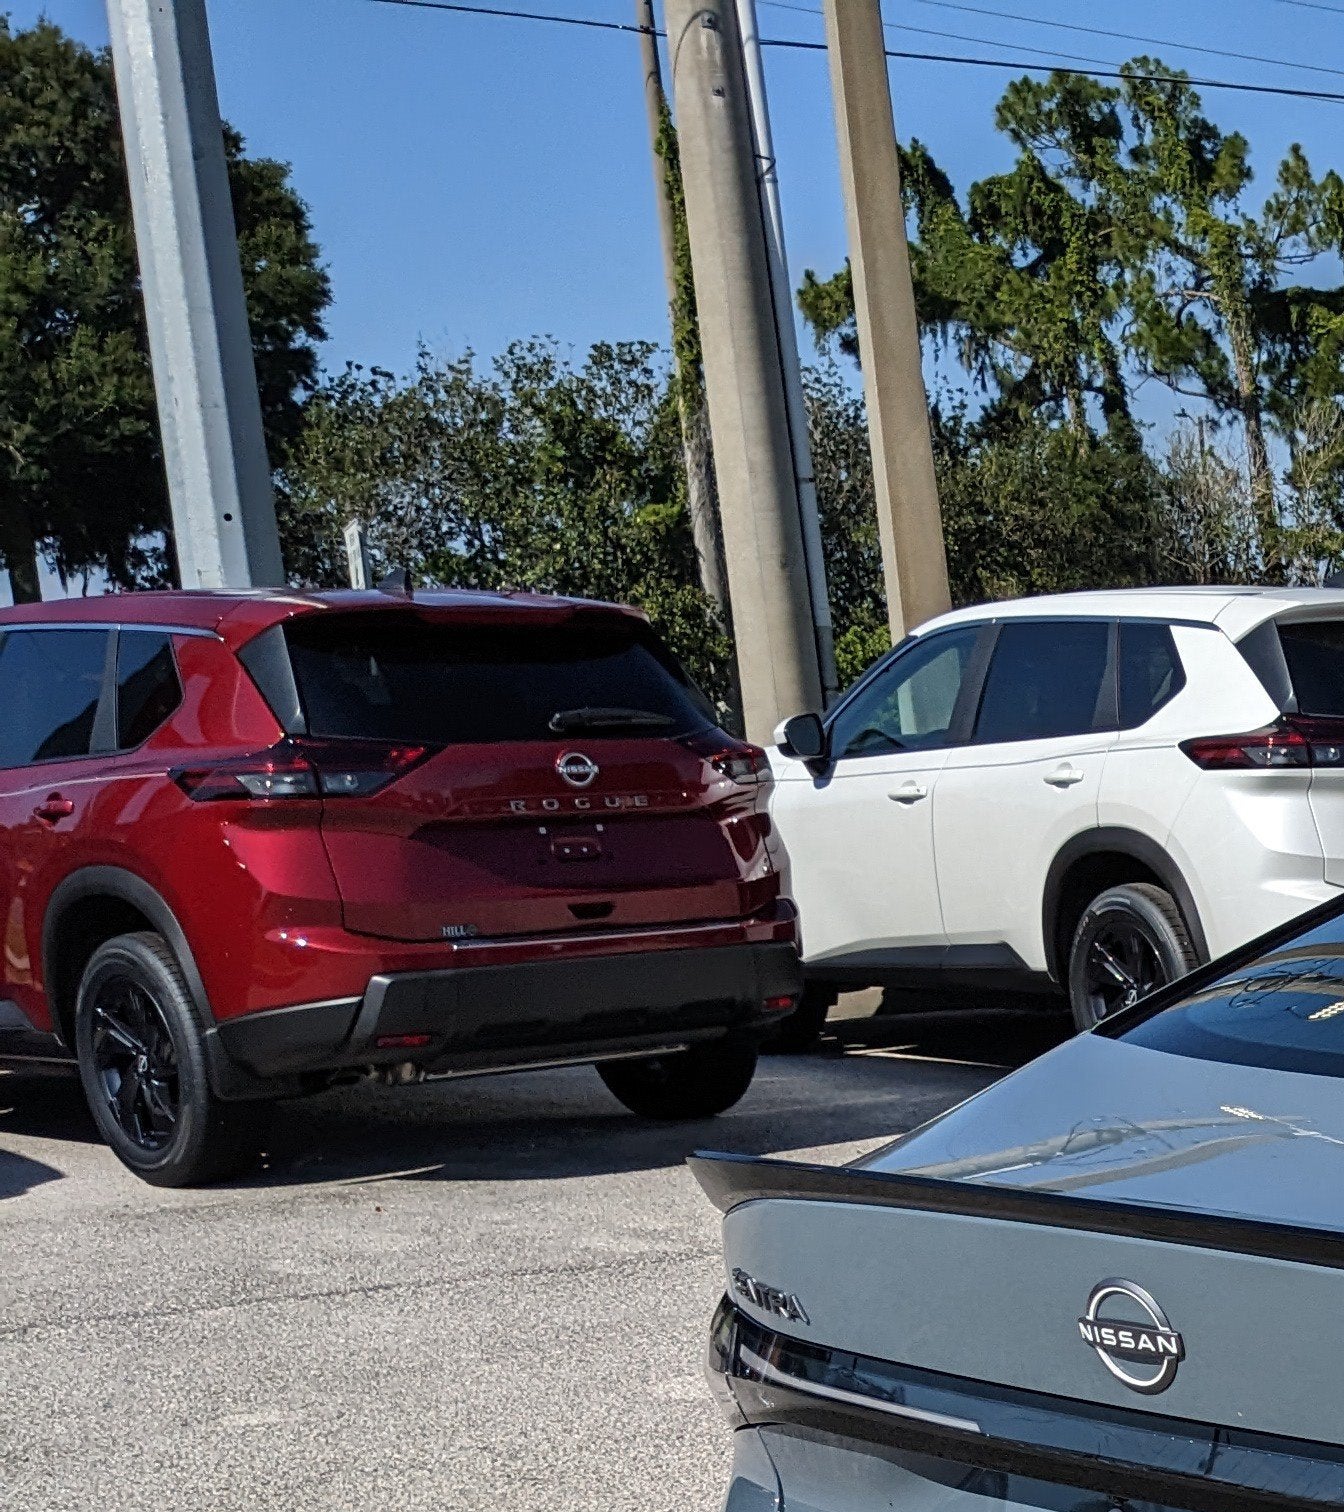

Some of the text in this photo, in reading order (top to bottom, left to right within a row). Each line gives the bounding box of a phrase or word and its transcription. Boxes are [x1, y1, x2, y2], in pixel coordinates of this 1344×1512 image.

[509, 796, 649, 813] ROGUE
[442, 925, 467, 937] HILL
[1078, 1321, 1179, 1355] NISSAN
